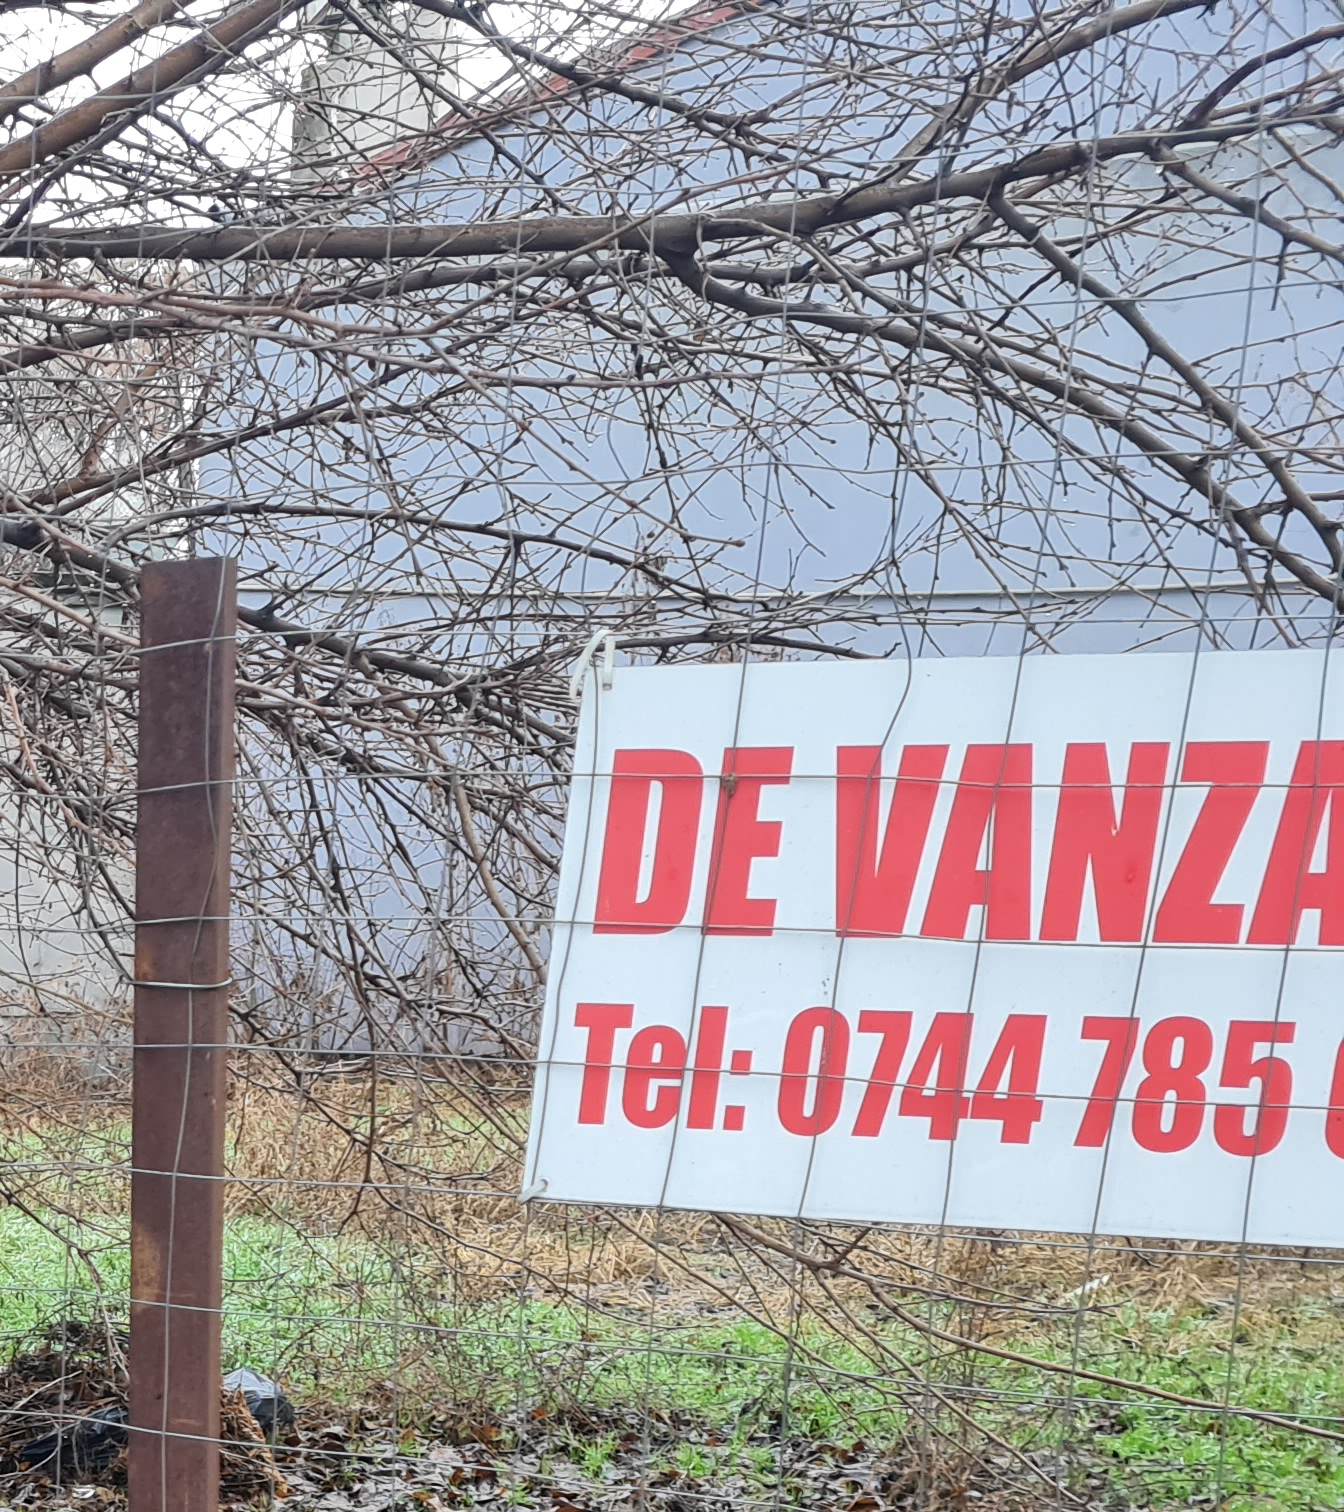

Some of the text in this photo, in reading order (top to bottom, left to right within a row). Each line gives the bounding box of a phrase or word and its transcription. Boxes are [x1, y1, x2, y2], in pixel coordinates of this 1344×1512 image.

[592, 740, 1344, 947] DE VANZA
[573, 1002, 753, 1132] Tel:
[776, 1005, 1048, 1146] 0744
[1072, 1015, 1297, 1158] 785
